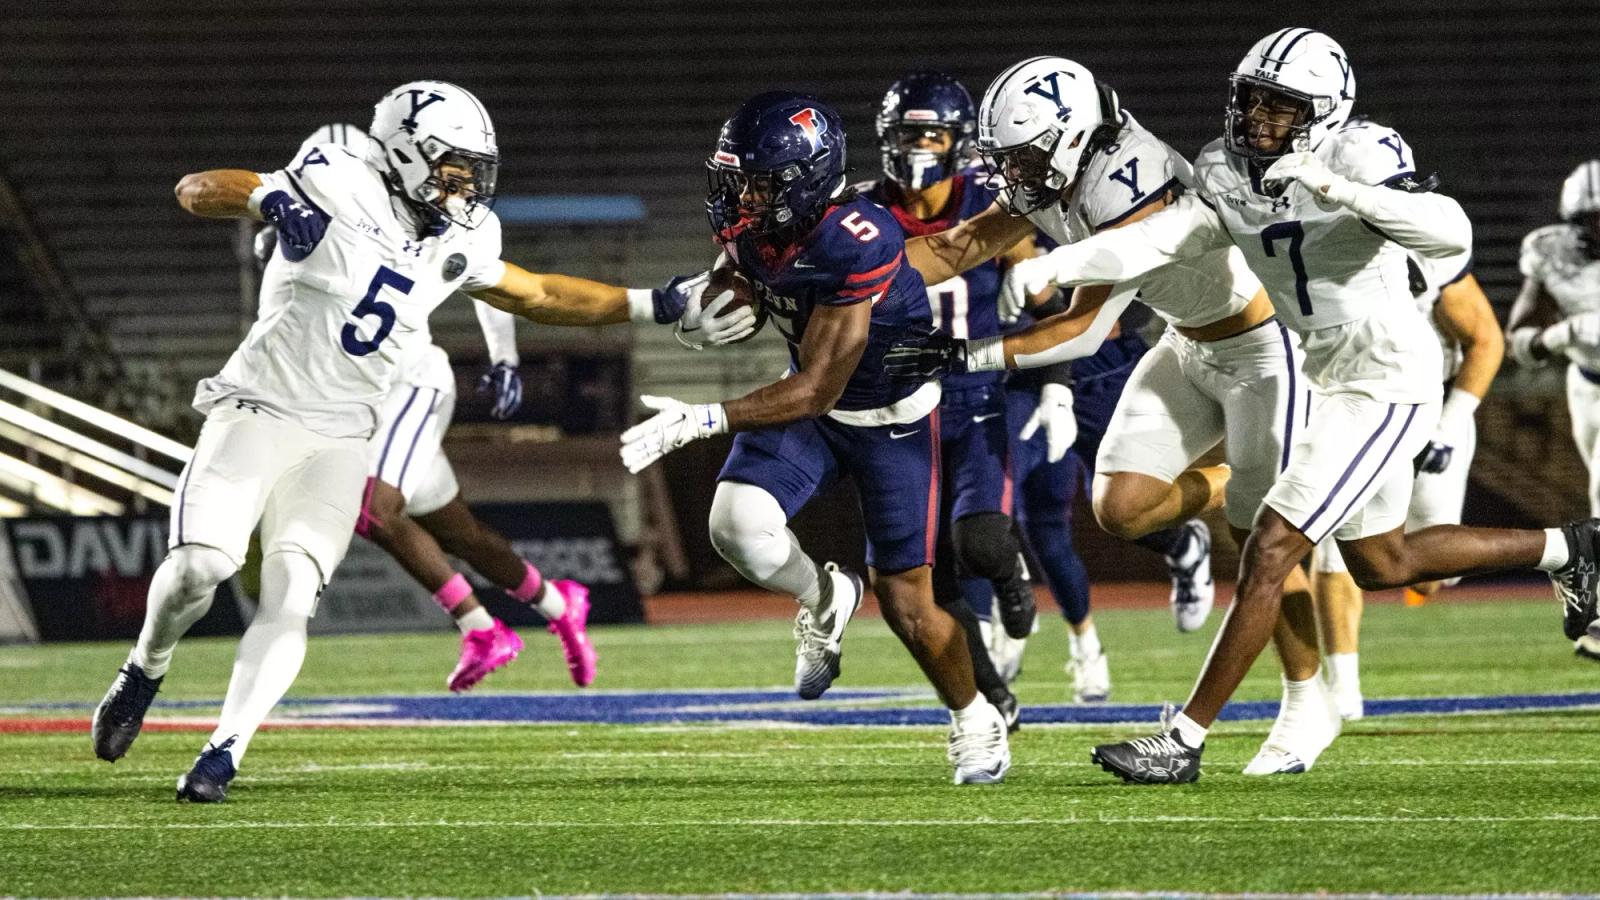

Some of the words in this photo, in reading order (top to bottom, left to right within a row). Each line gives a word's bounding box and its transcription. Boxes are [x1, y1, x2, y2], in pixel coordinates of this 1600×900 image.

[1024, 72, 1073, 119] Y
[1254, 68, 1280, 82] YALE
[1330, 51, 1352, 96] Y
[402, 89, 446, 129] Y
[789, 107, 831, 161] P
[1377, 133, 1408, 169] Y
[294, 147, 331, 178] Y
[1108, 157, 1146, 204] Y
[840, 211, 881, 242] 5
[1260, 220, 1314, 316] 7
[340, 264, 416, 357] 5
